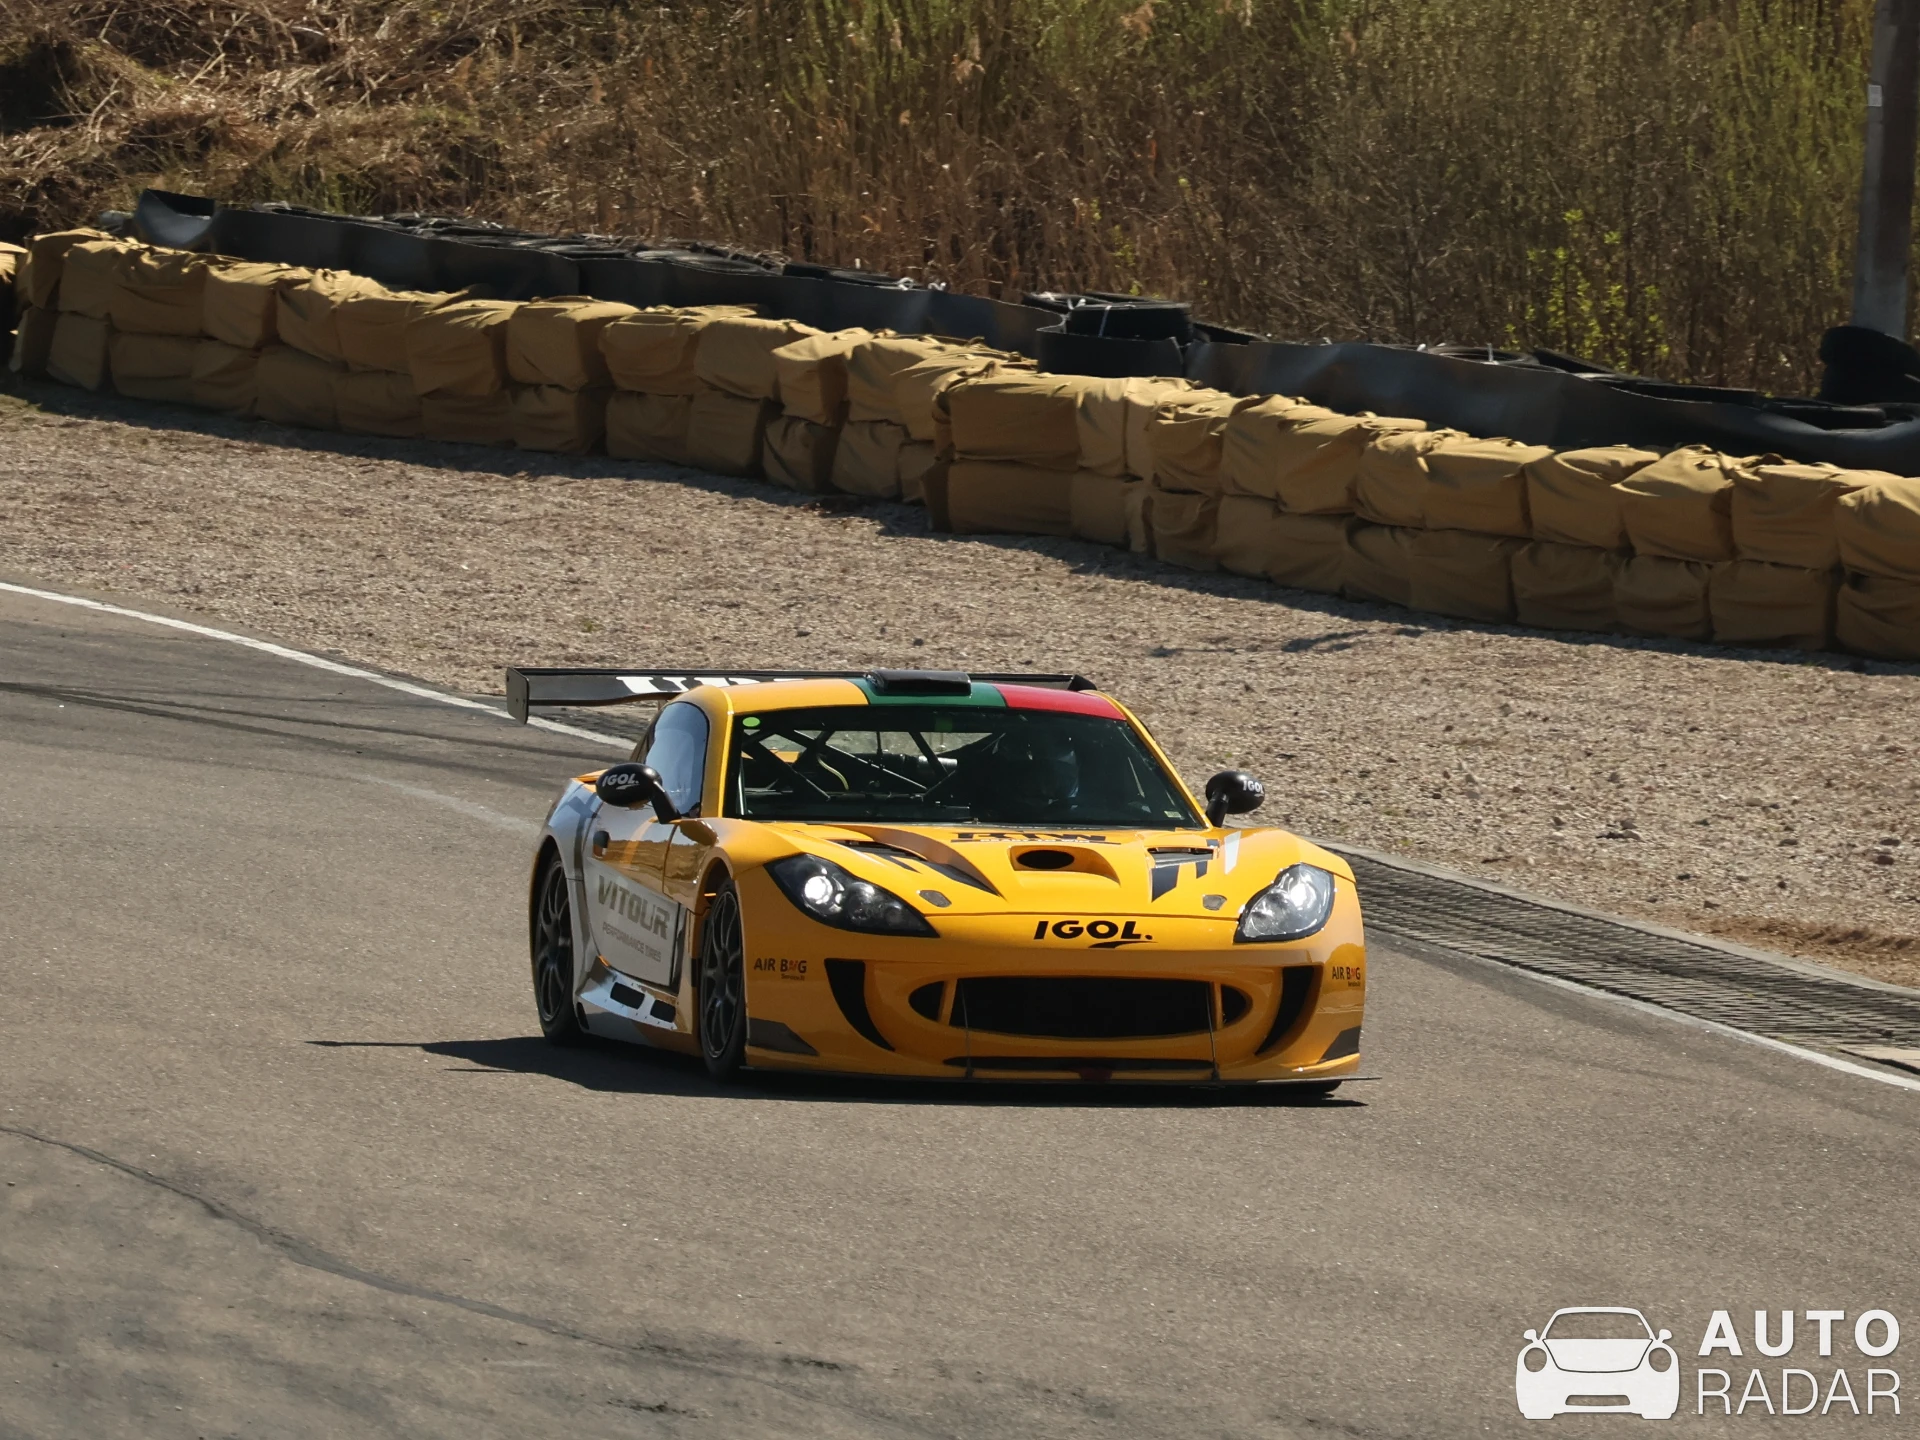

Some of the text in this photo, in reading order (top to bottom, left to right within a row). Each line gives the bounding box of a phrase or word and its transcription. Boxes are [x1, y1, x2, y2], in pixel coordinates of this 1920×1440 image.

[598, 874, 671, 941] VITOUR
[753, 957, 776, 972] AIR
[1331, 966, 1346, 981] AIR
